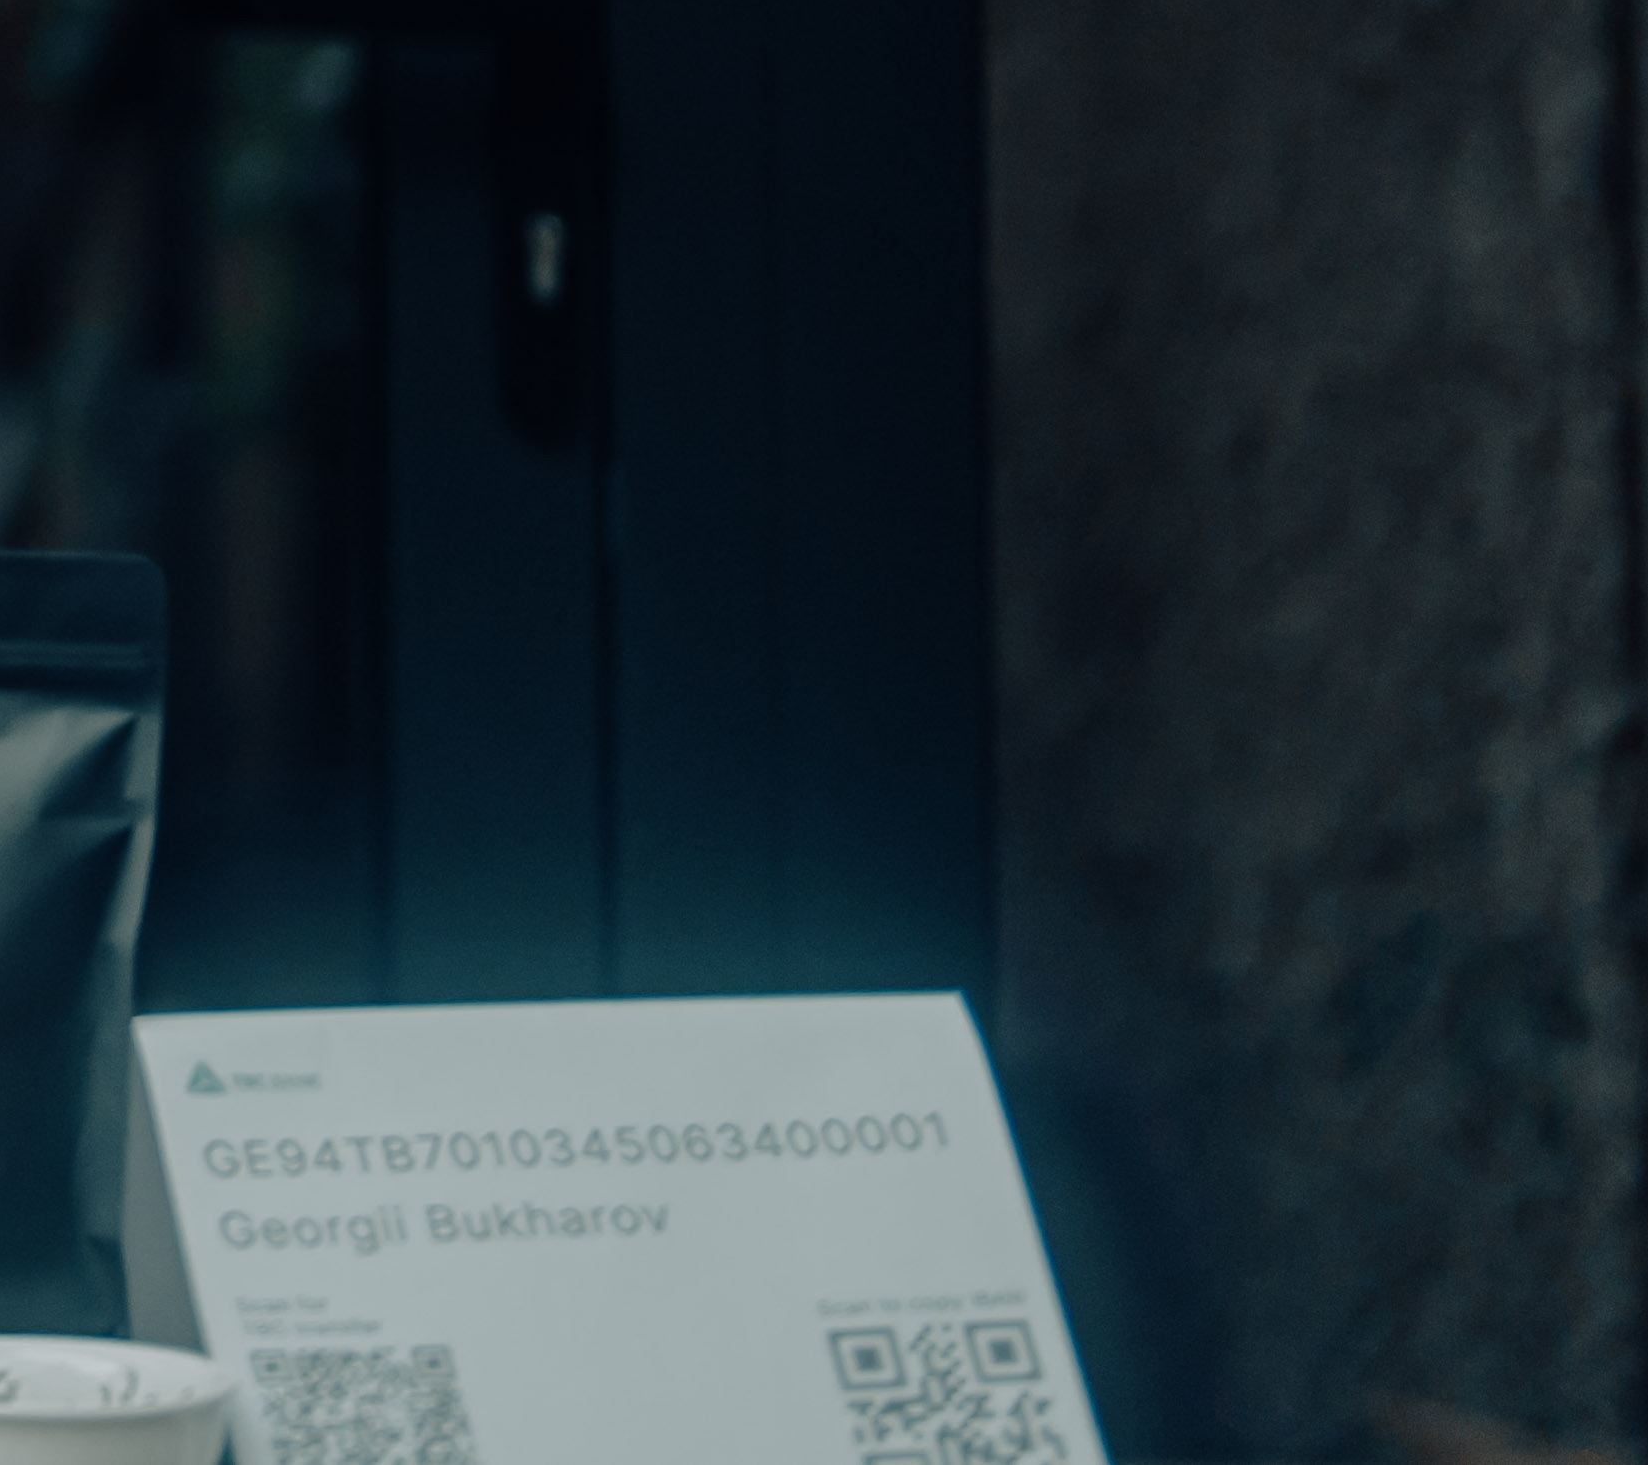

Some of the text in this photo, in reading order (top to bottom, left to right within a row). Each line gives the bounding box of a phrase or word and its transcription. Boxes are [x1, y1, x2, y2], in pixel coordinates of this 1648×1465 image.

[201, 1110, 952, 1179] GE94TB7010345063400001
[218, 1201, 671, 1256] Georgii Bukharov
